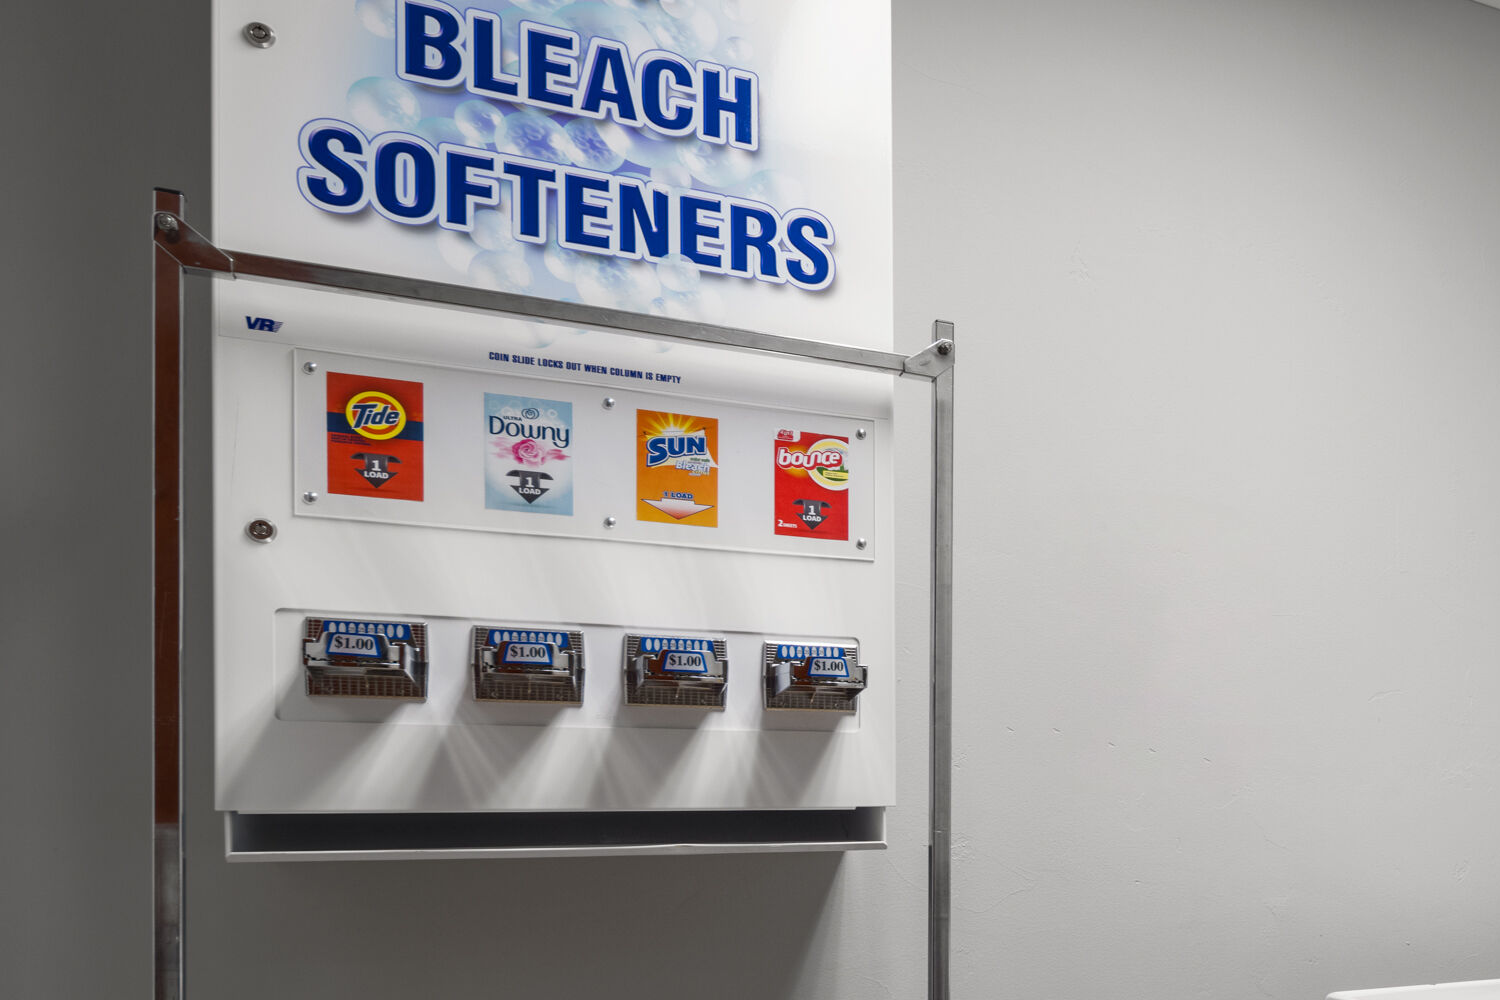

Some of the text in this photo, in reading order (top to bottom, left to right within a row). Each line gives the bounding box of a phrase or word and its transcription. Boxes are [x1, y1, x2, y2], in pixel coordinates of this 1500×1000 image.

[402, 0, 756, 148] BLEACH
[304, 124, 834, 287] SOFTENERS
[488, 351, 681, 384] COIN SLIDE LOCKS OUT WHEN COLUMN IS EMPTY
[352, 403, 400, 429] Tide
[489, 415, 570, 449] Downy
[647, 436, 706, 466] SUN
[778, 448, 841, 468] bounce
[371, 460, 381, 471] 1
[364, 471, 389, 479] LOAD
[525, 477, 535, 488] 1
[519, 487, 541, 495] LOAD
[671, 492, 694, 500] LOAD
[808, 505, 816, 515] 1
[777, 519, 783, 527] 2
[334, 635, 374, 651] $1.00
[510, 645, 546, 658] $1.00
[669, 654, 701, 667] $1.00
[814, 660, 844, 672] $1.00
